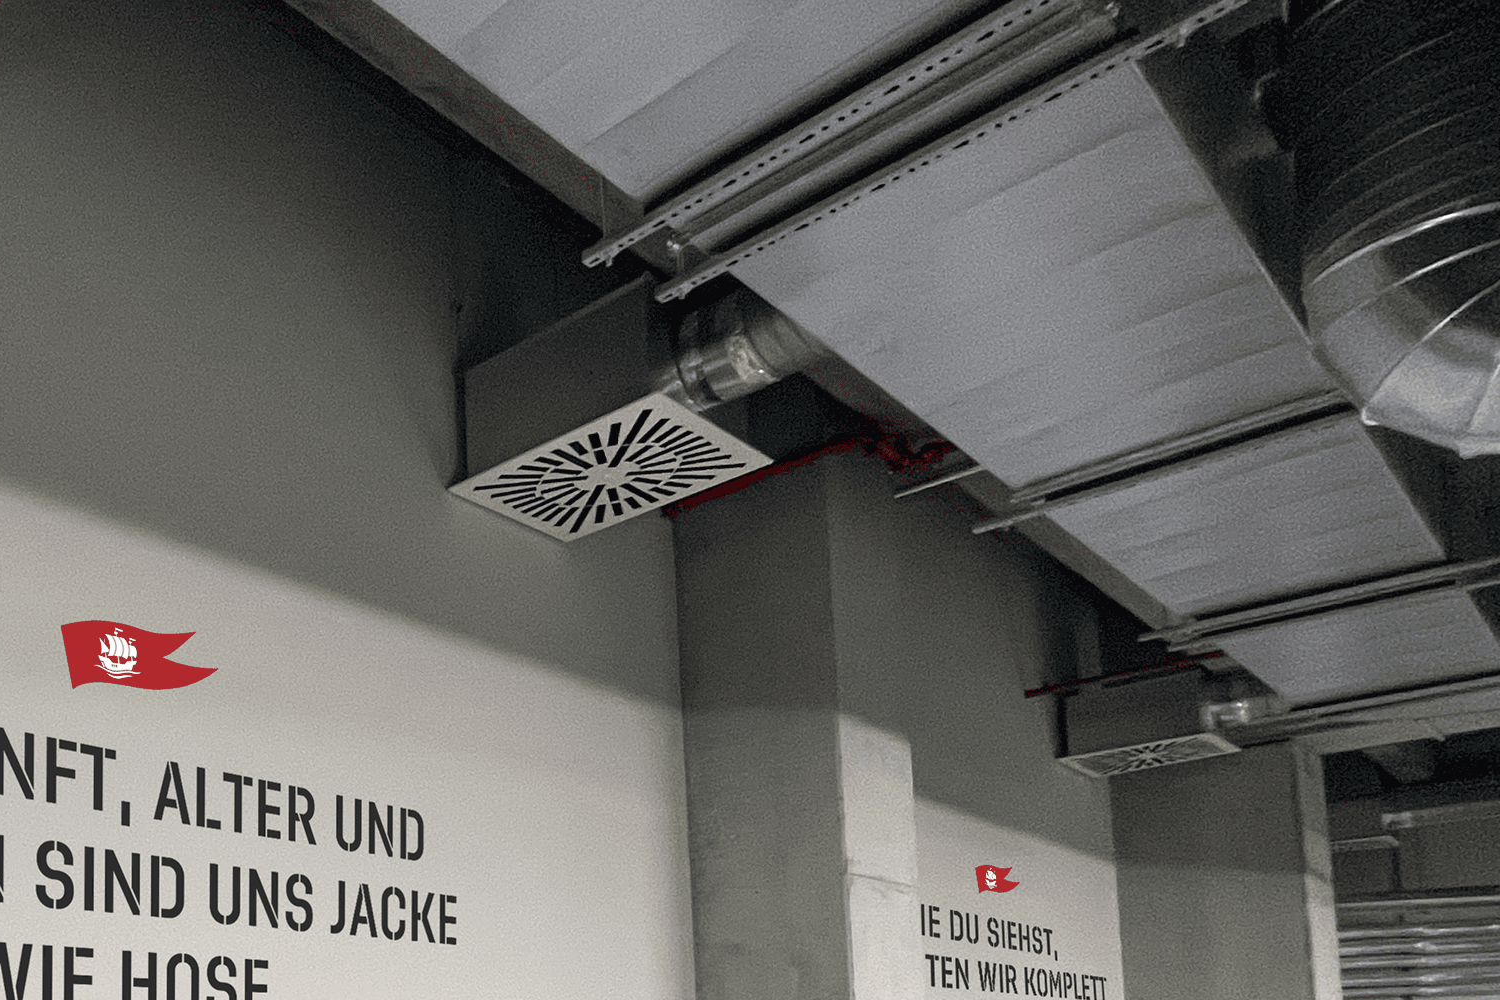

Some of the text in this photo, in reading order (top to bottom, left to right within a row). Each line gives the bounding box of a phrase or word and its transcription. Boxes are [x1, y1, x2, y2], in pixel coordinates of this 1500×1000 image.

[153, 761, 317, 846] ALTER
[335, 794, 424, 861] UND
[35, 840, 185, 919] SIND
[209, 863, 313, 932] UNS
[330, 880, 458, 946] JACKE
[949, 909, 979, 945] DU
[986, 917, 1058, 962] SIEHST,
[977, 960, 1018, 995] WIR
